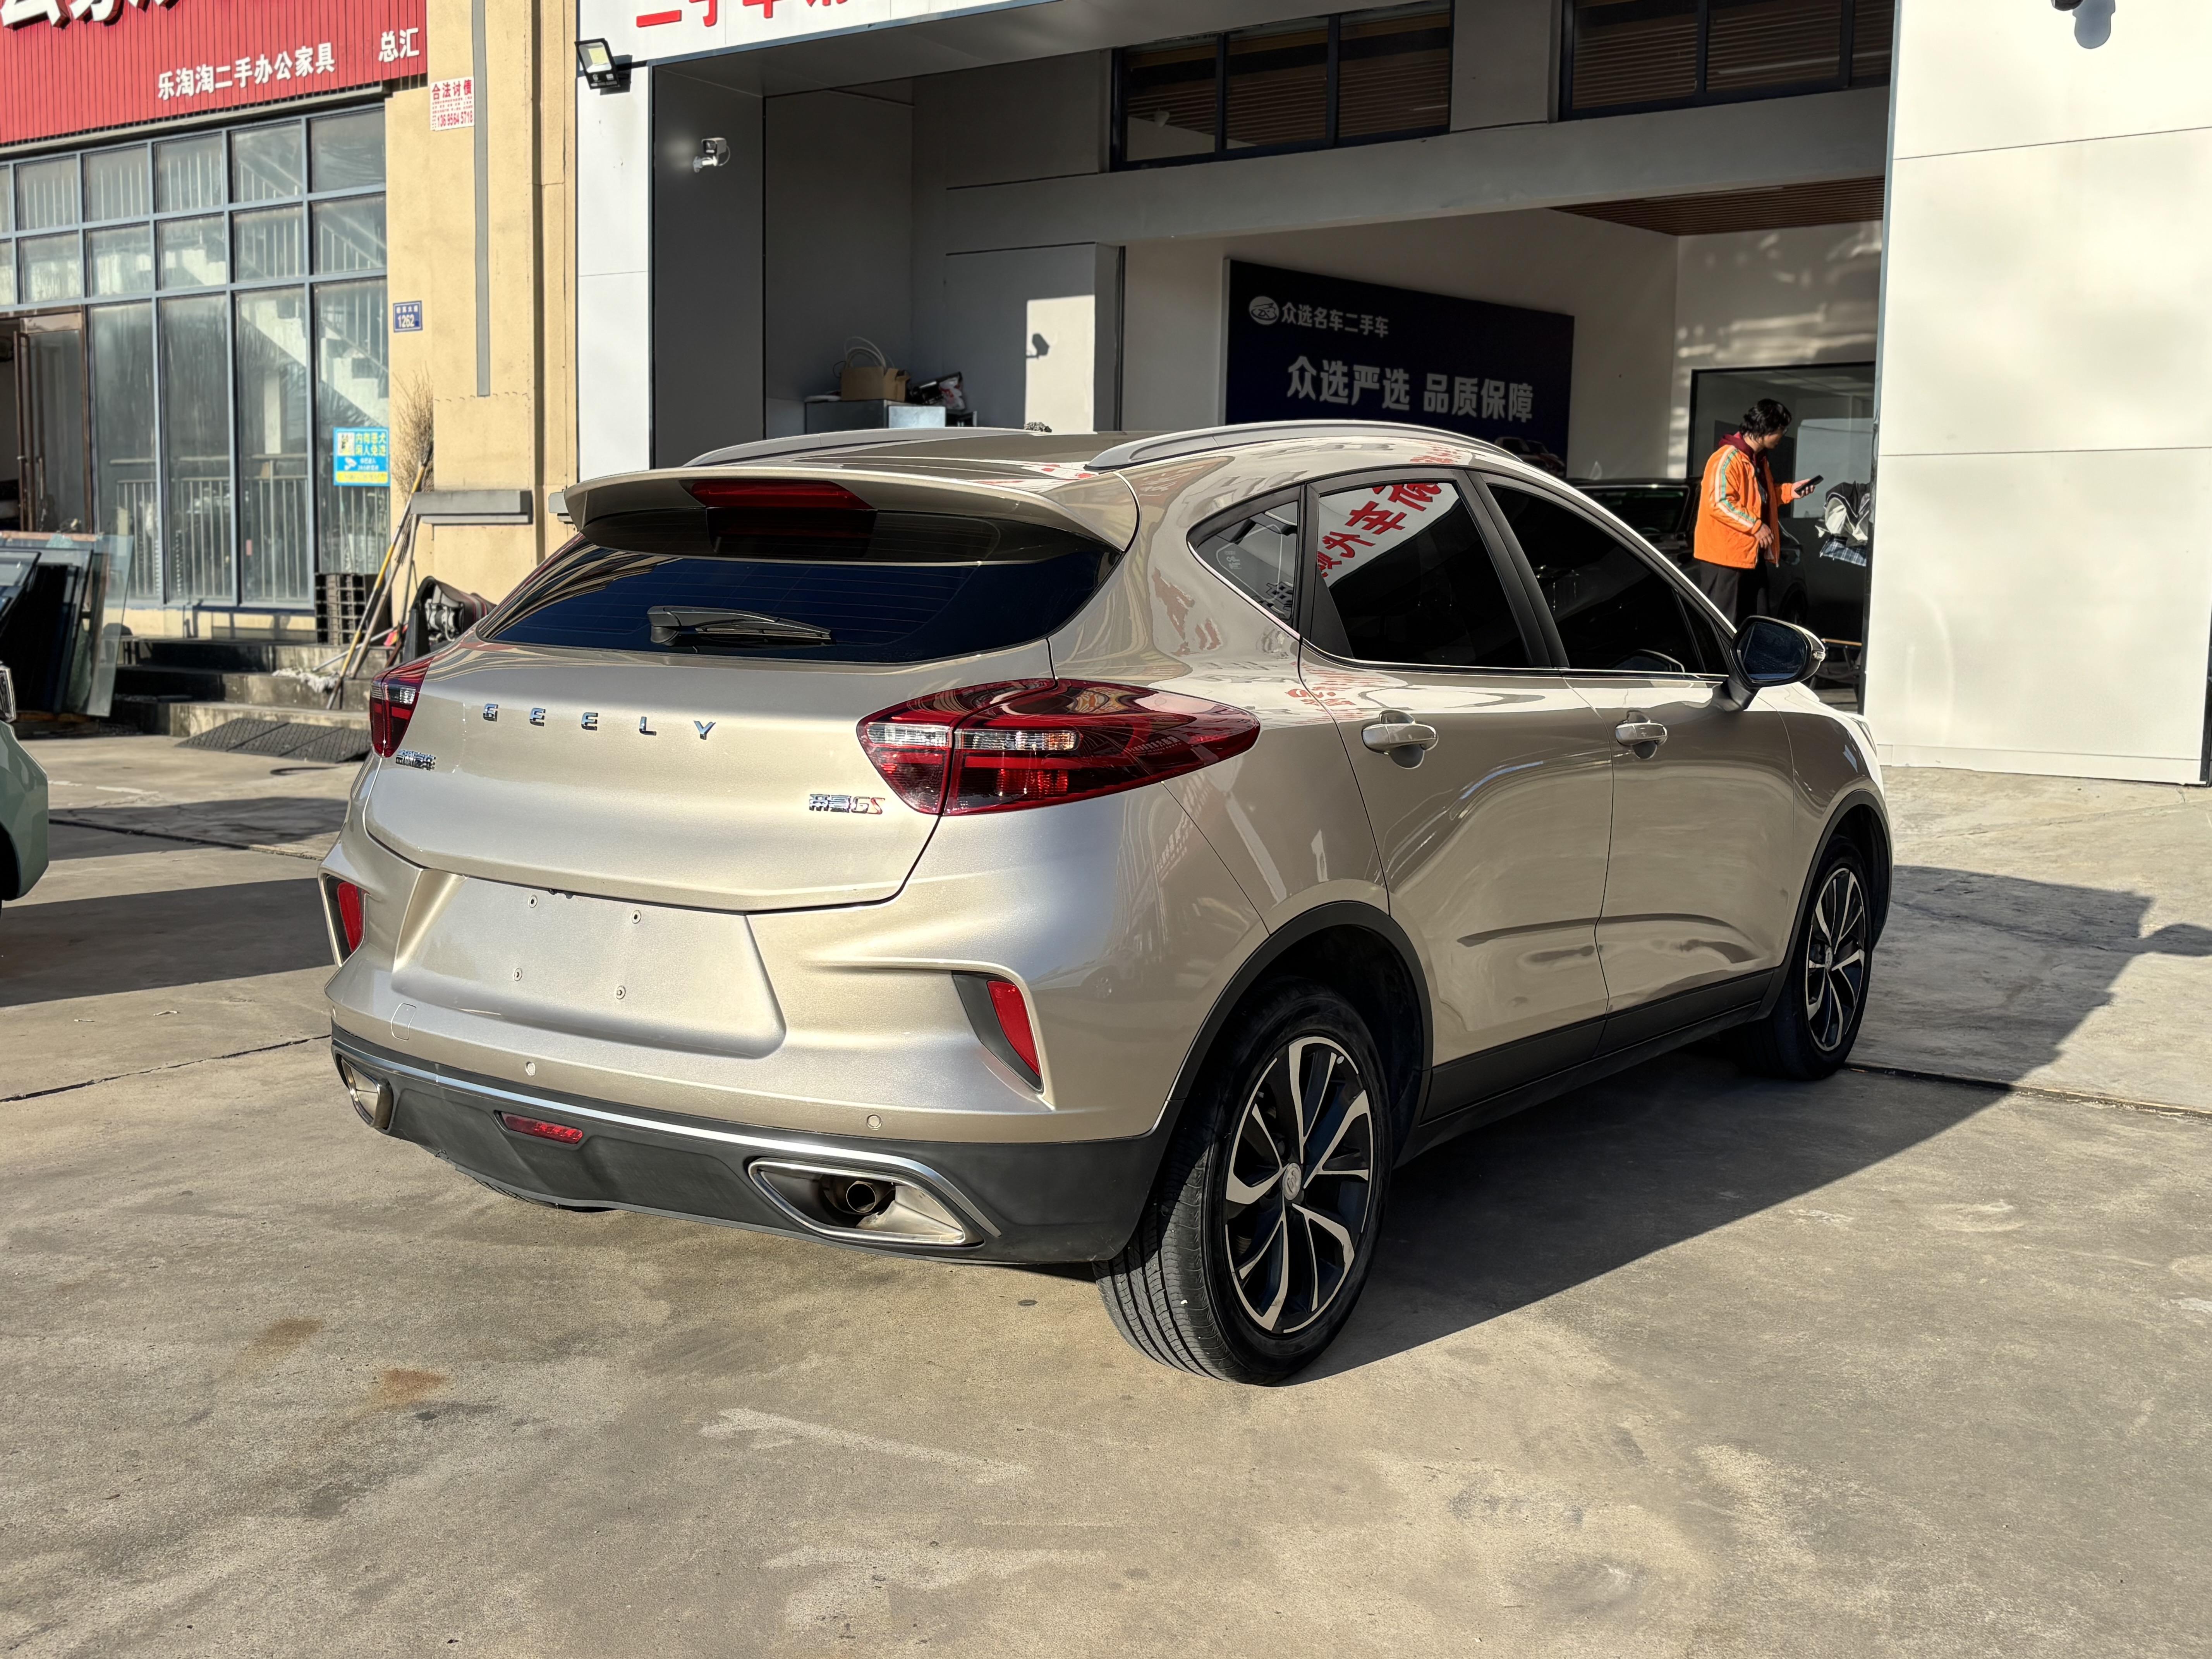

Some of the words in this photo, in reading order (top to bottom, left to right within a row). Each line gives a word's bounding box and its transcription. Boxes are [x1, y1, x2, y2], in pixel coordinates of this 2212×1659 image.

[158, 42, 335, 101] 乐淘淘二手办公家具
[378, 27, 420, 62] 总汇
[398, 314, 415, 328] 1262
[1281, 302, 1389, 338] 众选名车二手车
[1287, 356, 1410, 410] 众选严选
[1423, 373, 1533, 422] 品质保障
[483, 703, 716, 740] GEELY
